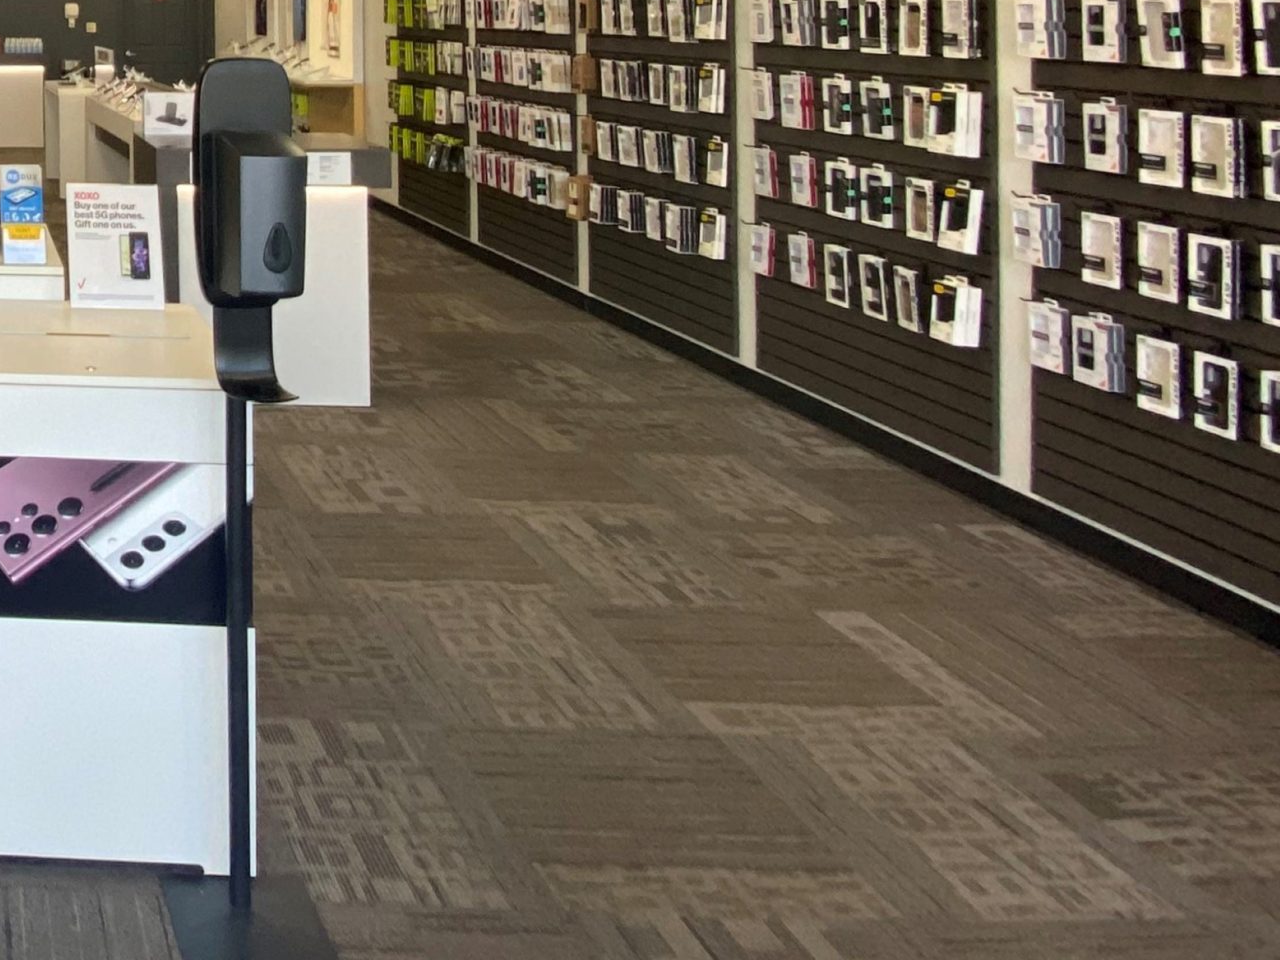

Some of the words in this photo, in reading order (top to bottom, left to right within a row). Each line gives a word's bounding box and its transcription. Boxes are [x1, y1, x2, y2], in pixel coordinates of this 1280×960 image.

[74, 192, 100, 200] XOXO
[74, 201, 91, 211] Buy
[111, 201, 120, 210] of
[74, 211, 93, 219] best
[95, 211, 108, 219] 5G
[109, 211, 144, 220] phones.
[74, 220, 91, 228] Gift
[93, 221, 109, 229] one
[111, 221, 122, 229] on
